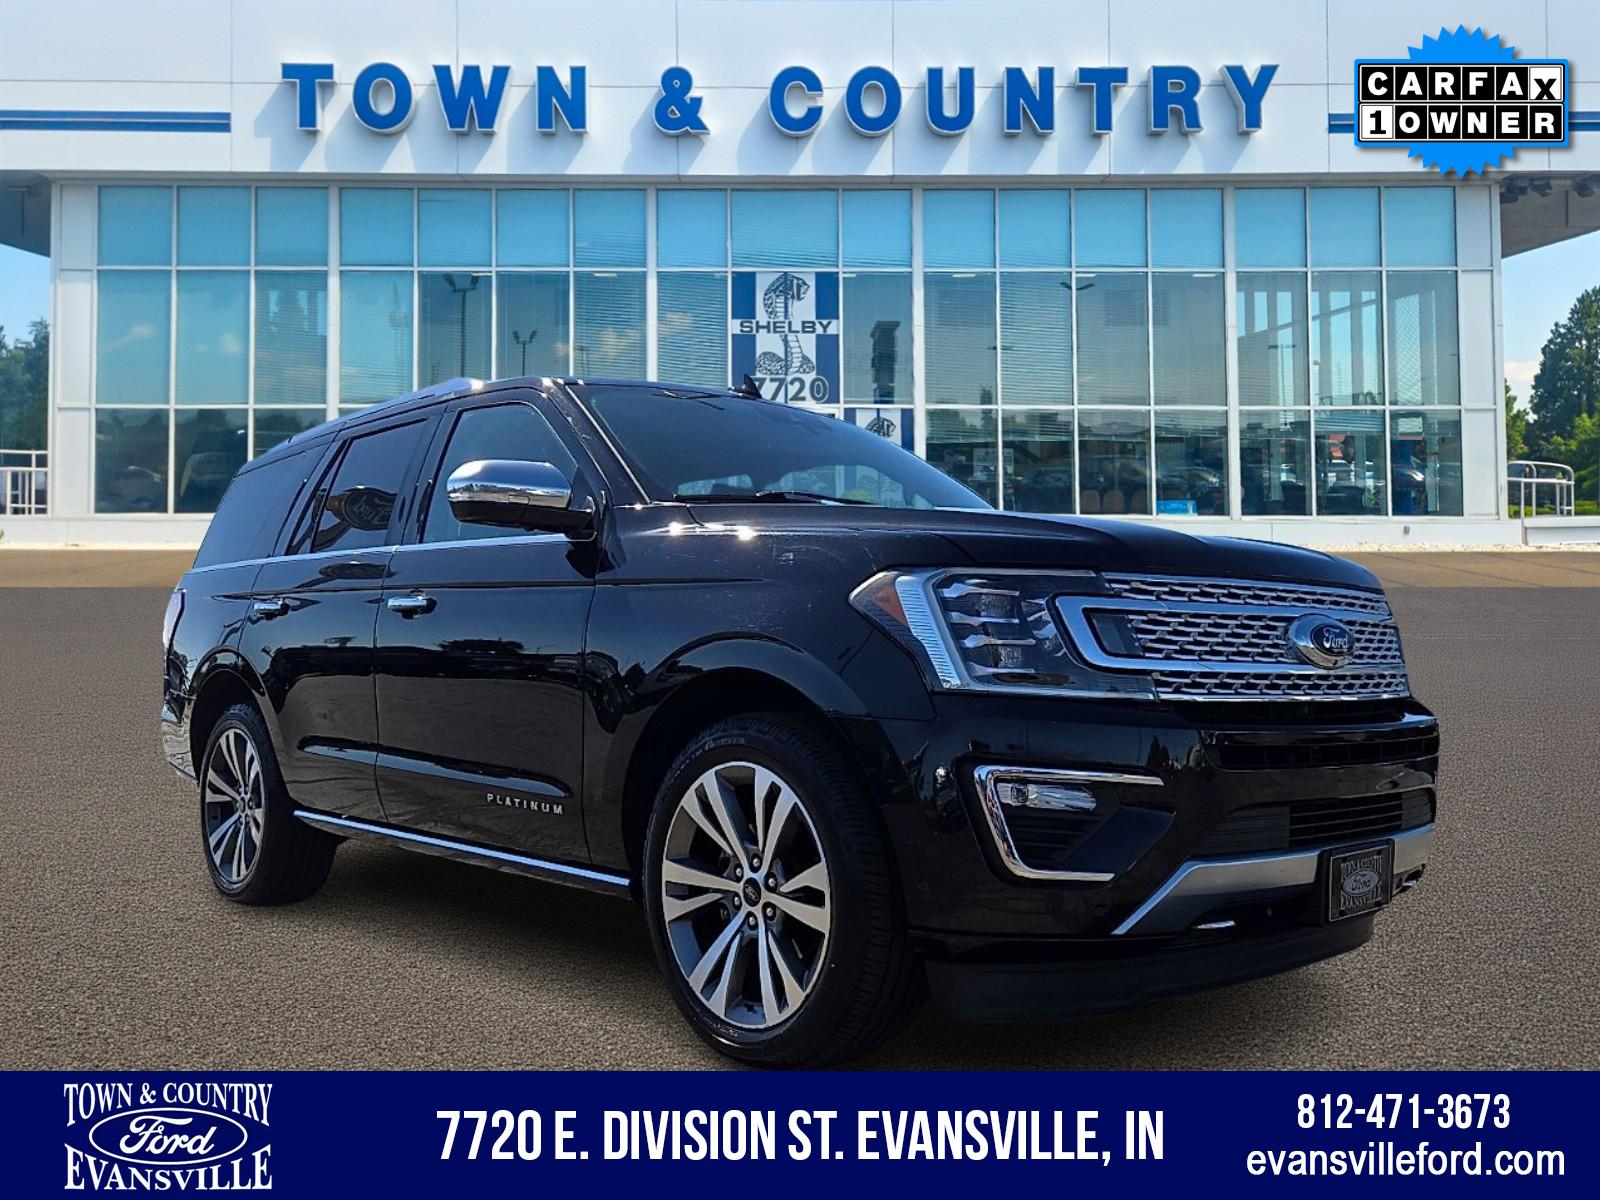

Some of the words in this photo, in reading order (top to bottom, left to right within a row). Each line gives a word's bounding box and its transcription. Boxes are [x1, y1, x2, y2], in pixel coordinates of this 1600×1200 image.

[281, 62, 588, 135] TOWN
[654, 66, 710, 136] &
[768, 64, 1280, 137] COUNTRY
[739, 320, 833, 334] SHELBY
[751, 376, 829, 403] 7720
[1322, 626, 1348, 649] Ford
[486, 793, 564, 815] PLATINUM
